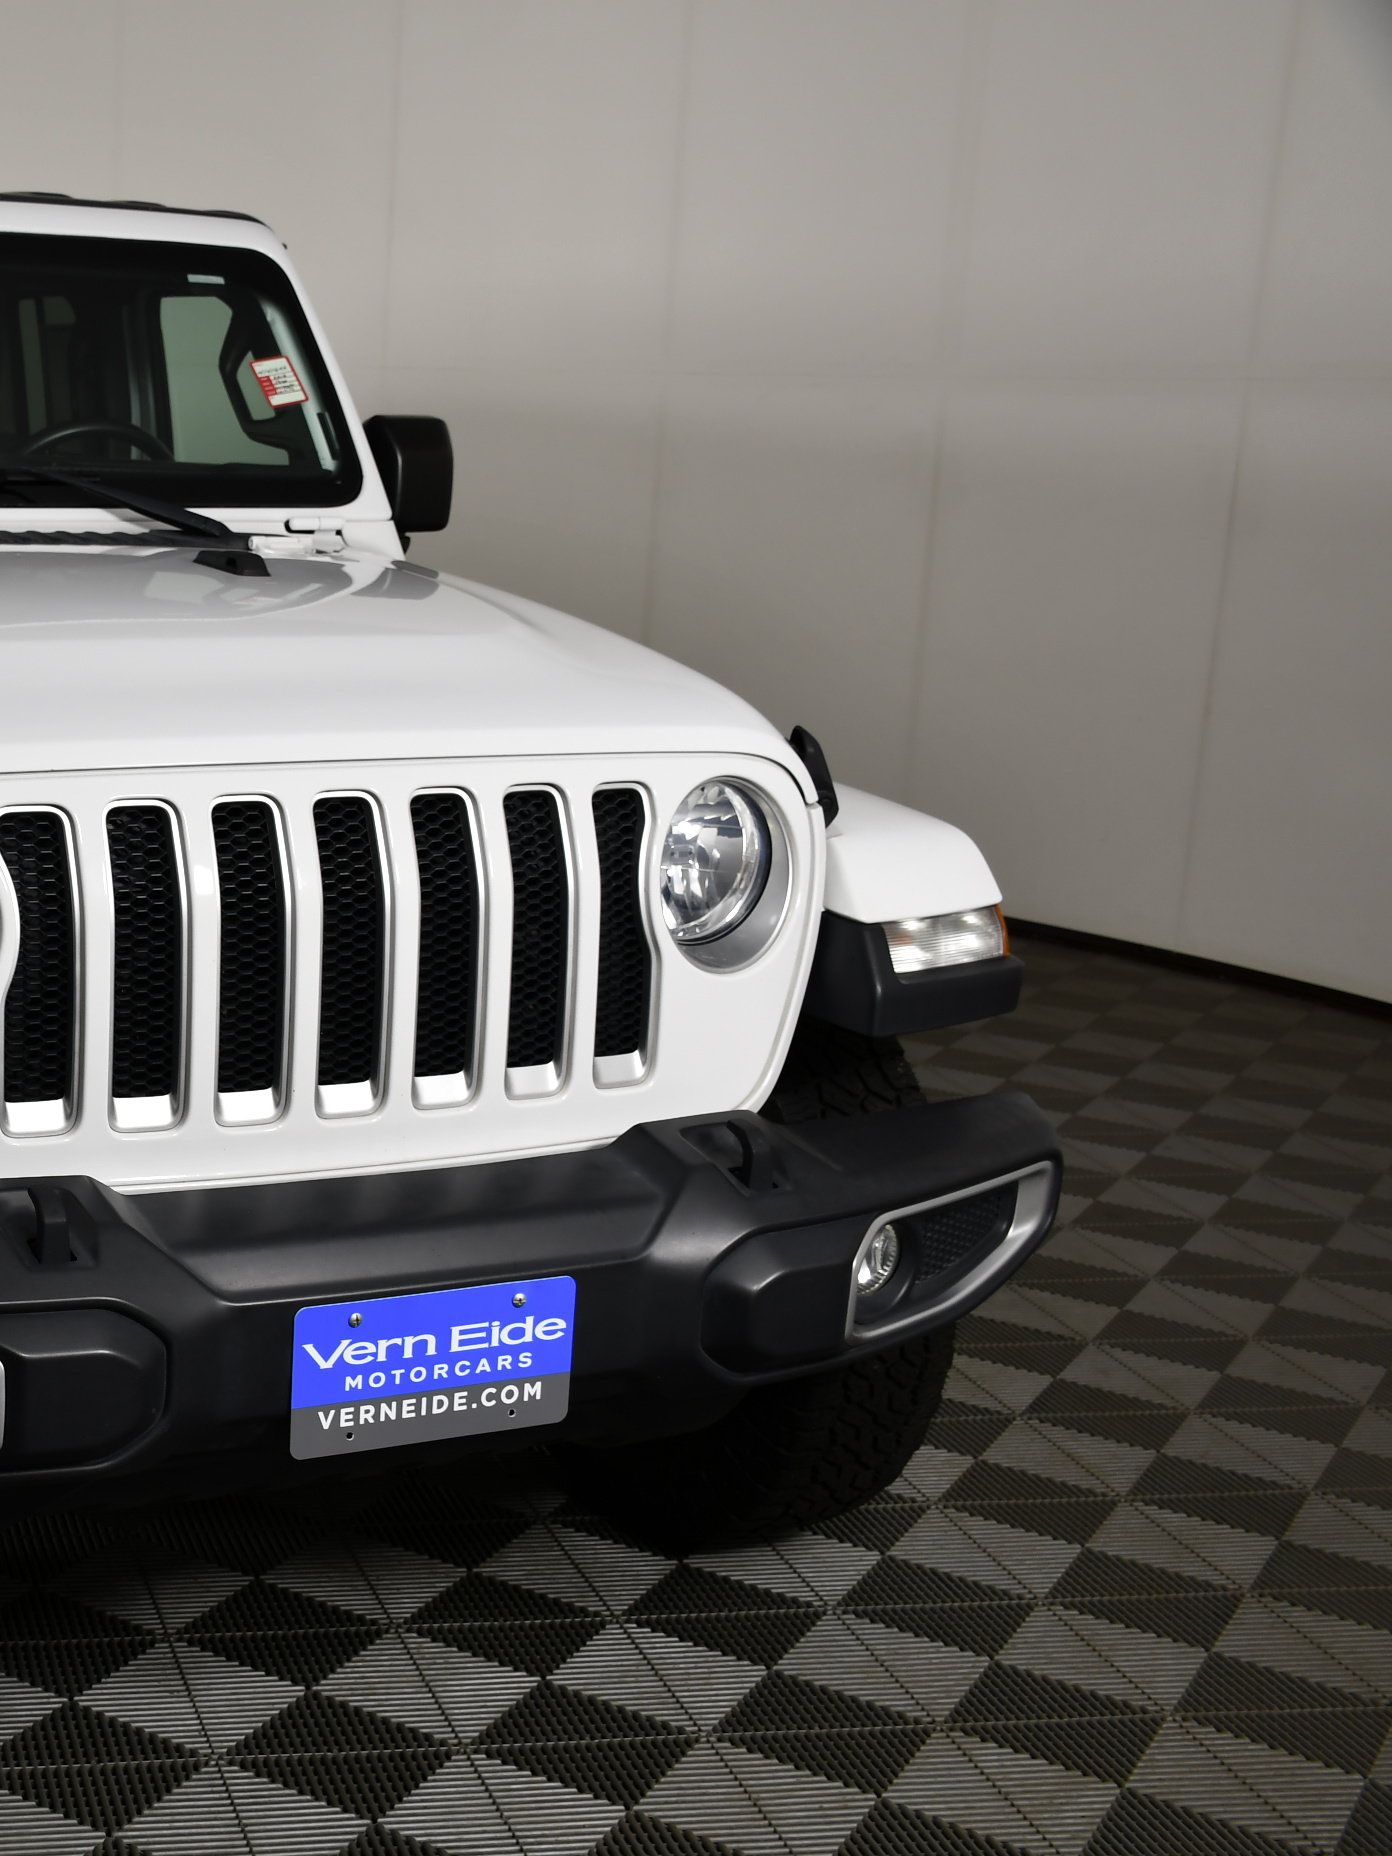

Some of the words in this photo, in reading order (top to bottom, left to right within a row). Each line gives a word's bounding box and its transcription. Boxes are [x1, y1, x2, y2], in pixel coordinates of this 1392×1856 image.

[302, 1332, 438, 1370] Vern
[449, 1315, 567, 1353] Eide
[345, 1352, 534, 1392] MOTORCARS
[317, 1381, 542, 1430] VERNEIDE.COM
